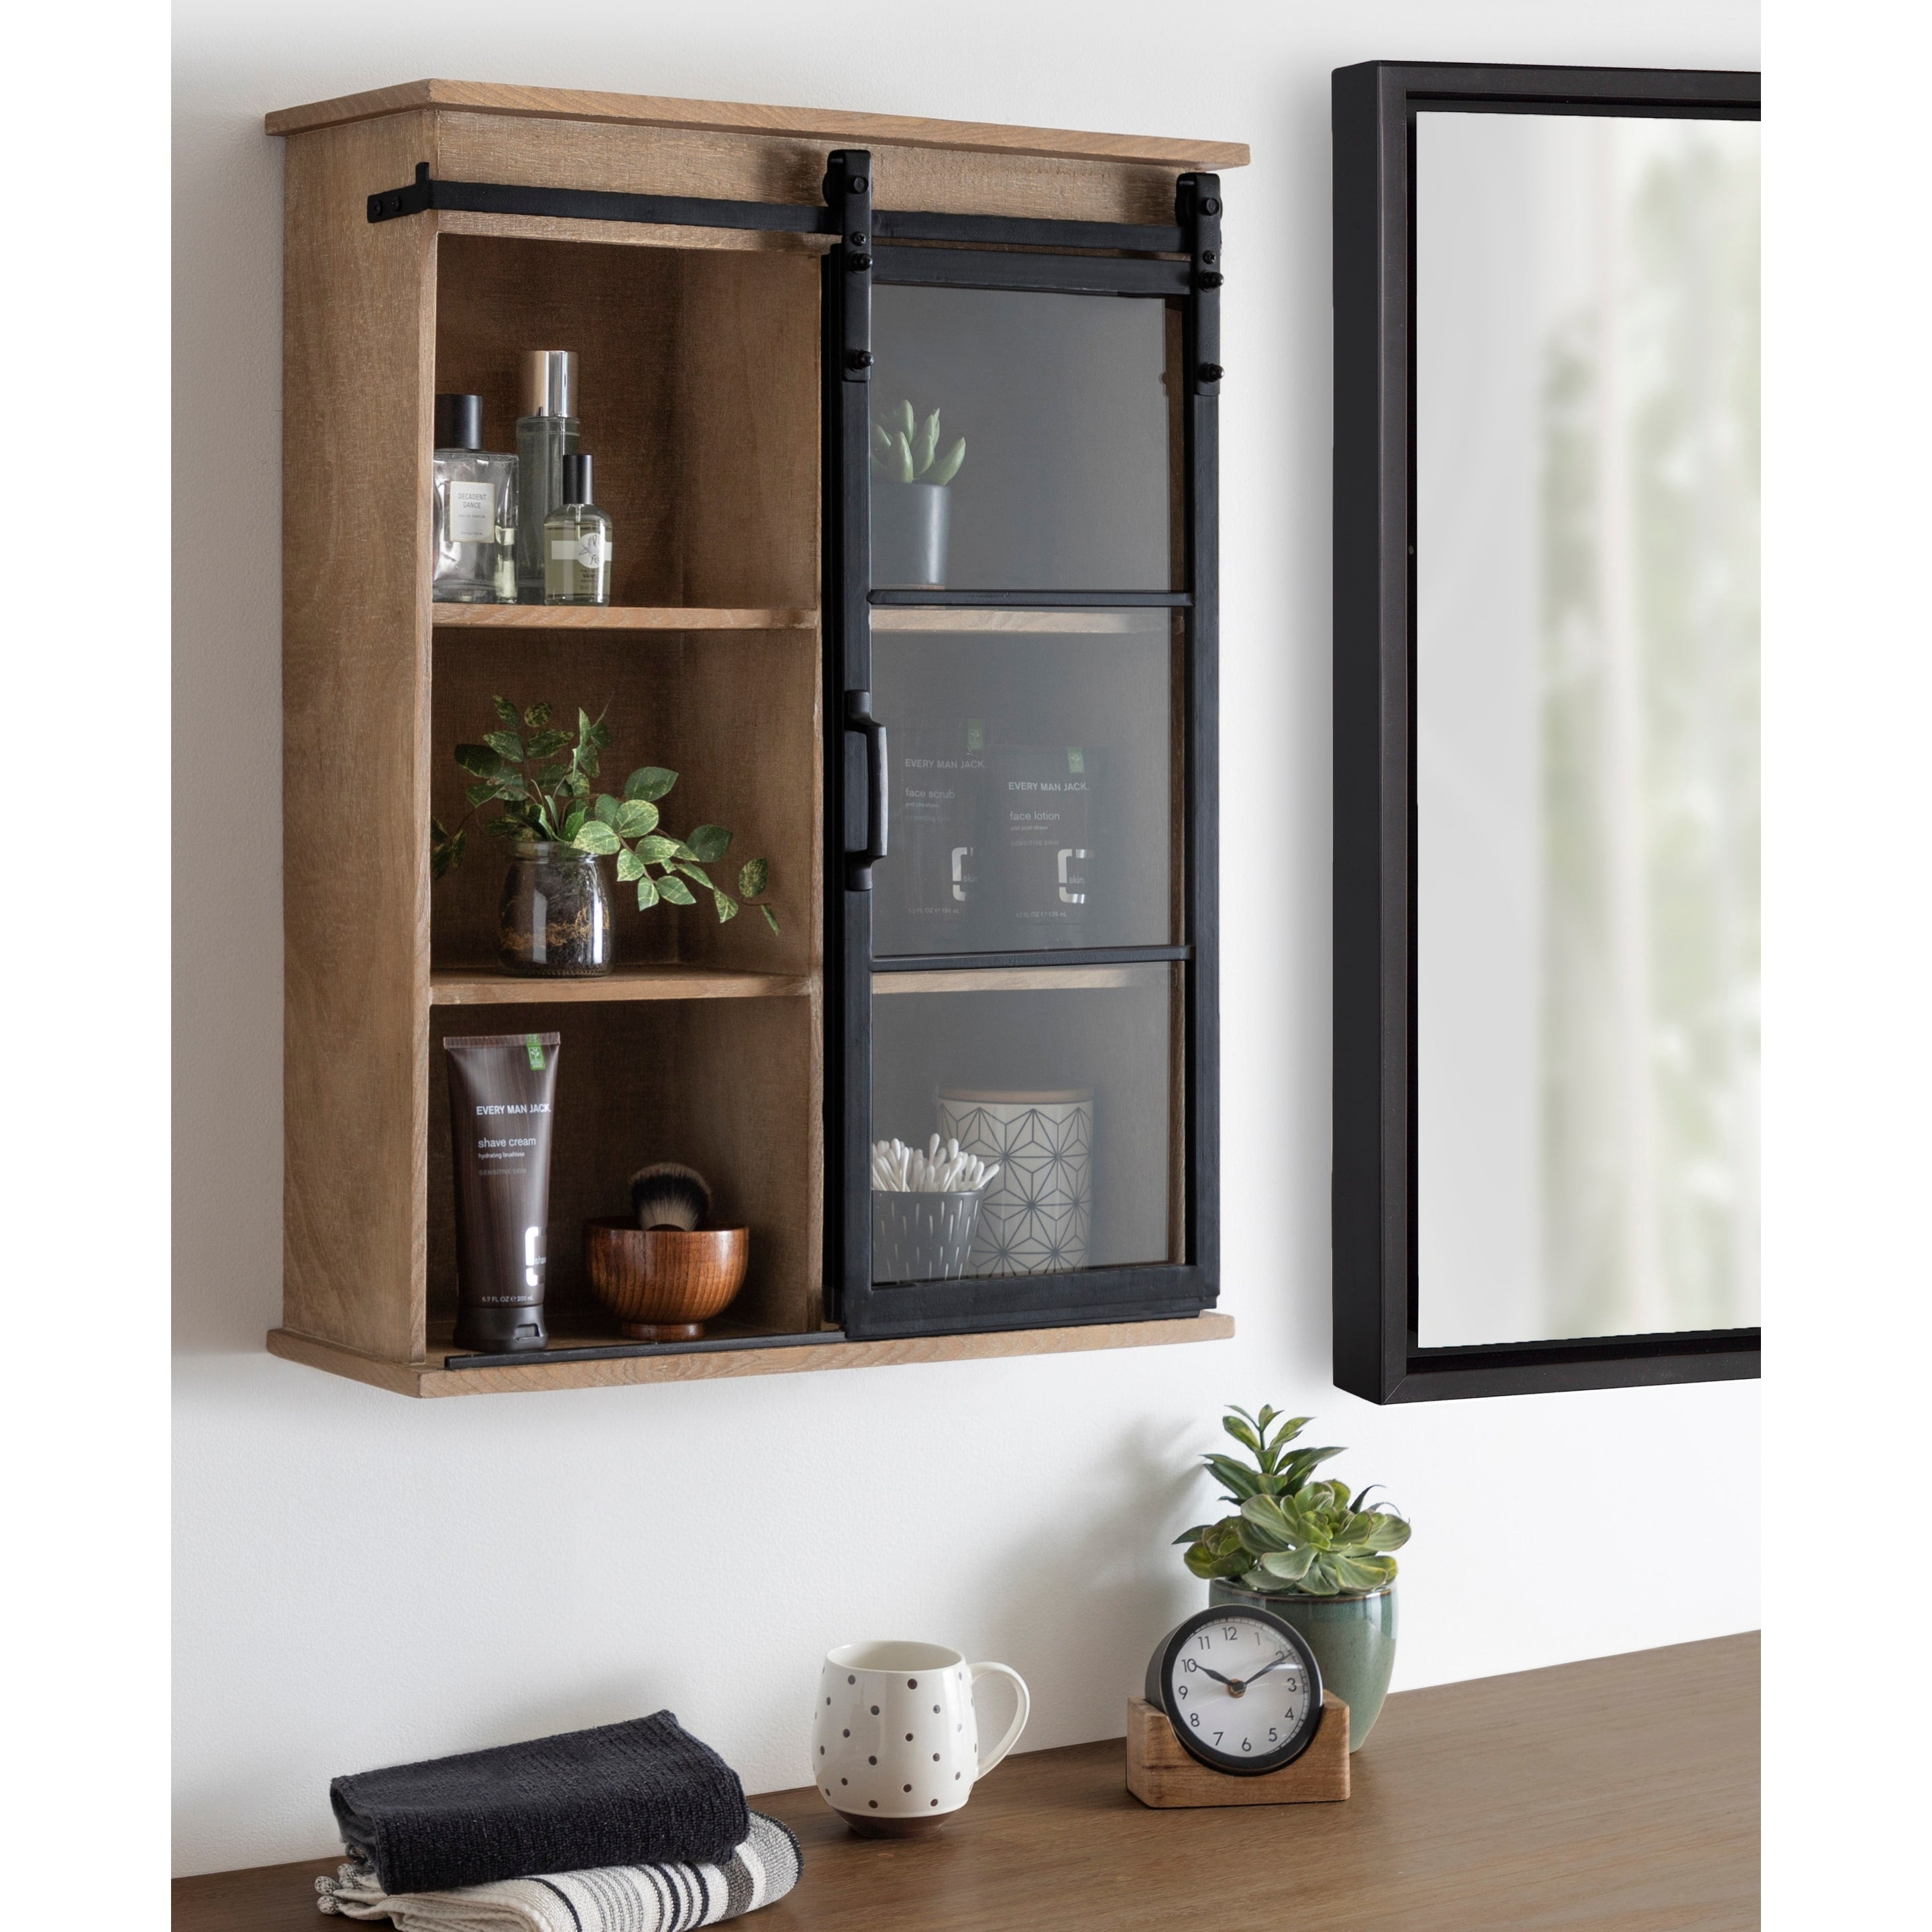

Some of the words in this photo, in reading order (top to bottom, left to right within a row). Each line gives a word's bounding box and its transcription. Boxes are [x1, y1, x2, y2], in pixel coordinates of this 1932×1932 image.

[458, 492, 487, 500] DECADENT
[463, 501, 482, 509] DANCE
[906, 758, 934, 768] EVERY
[937, 759, 957, 769] MAN
[906, 787, 925, 798] face
[928, 789, 955, 799] scrub
[1008, 782, 1038, 790] EVERY
[1040, 783, 1061, 791] MAN
[1010, 811, 1031, 820] face
[1034, 810, 1061, 820] lotion
[476, 1105, 505, 1116] EVERY
[507, 1104, 527, 1114] MAN
[478, 1137, 506, 1148] shave
[508, 1137, 537, 1146] cream
[478, 1152, 502, 1160] hydrating
[502, 1150, 525, 1159] brushless
[1222, 1627, 1238, 1641] 12
[1254, 1632, 1260, 1646] 1
[1197, 1635, 1210, 1650] 11
[1181, 1658, 1197, 1672] 10
[1287, 1677, 1297, 1692] 3
[1178, 1685, 1188, 1700] 9
[1190, 1713, 1200, 1727] 8
[1285, 1707, 1295, 1721] 4
[1213, 1731, 1224, 1746] 7
[1269, 1727, 1278, 1742] 5
[1242, 1737, 1252, 1752] 6
